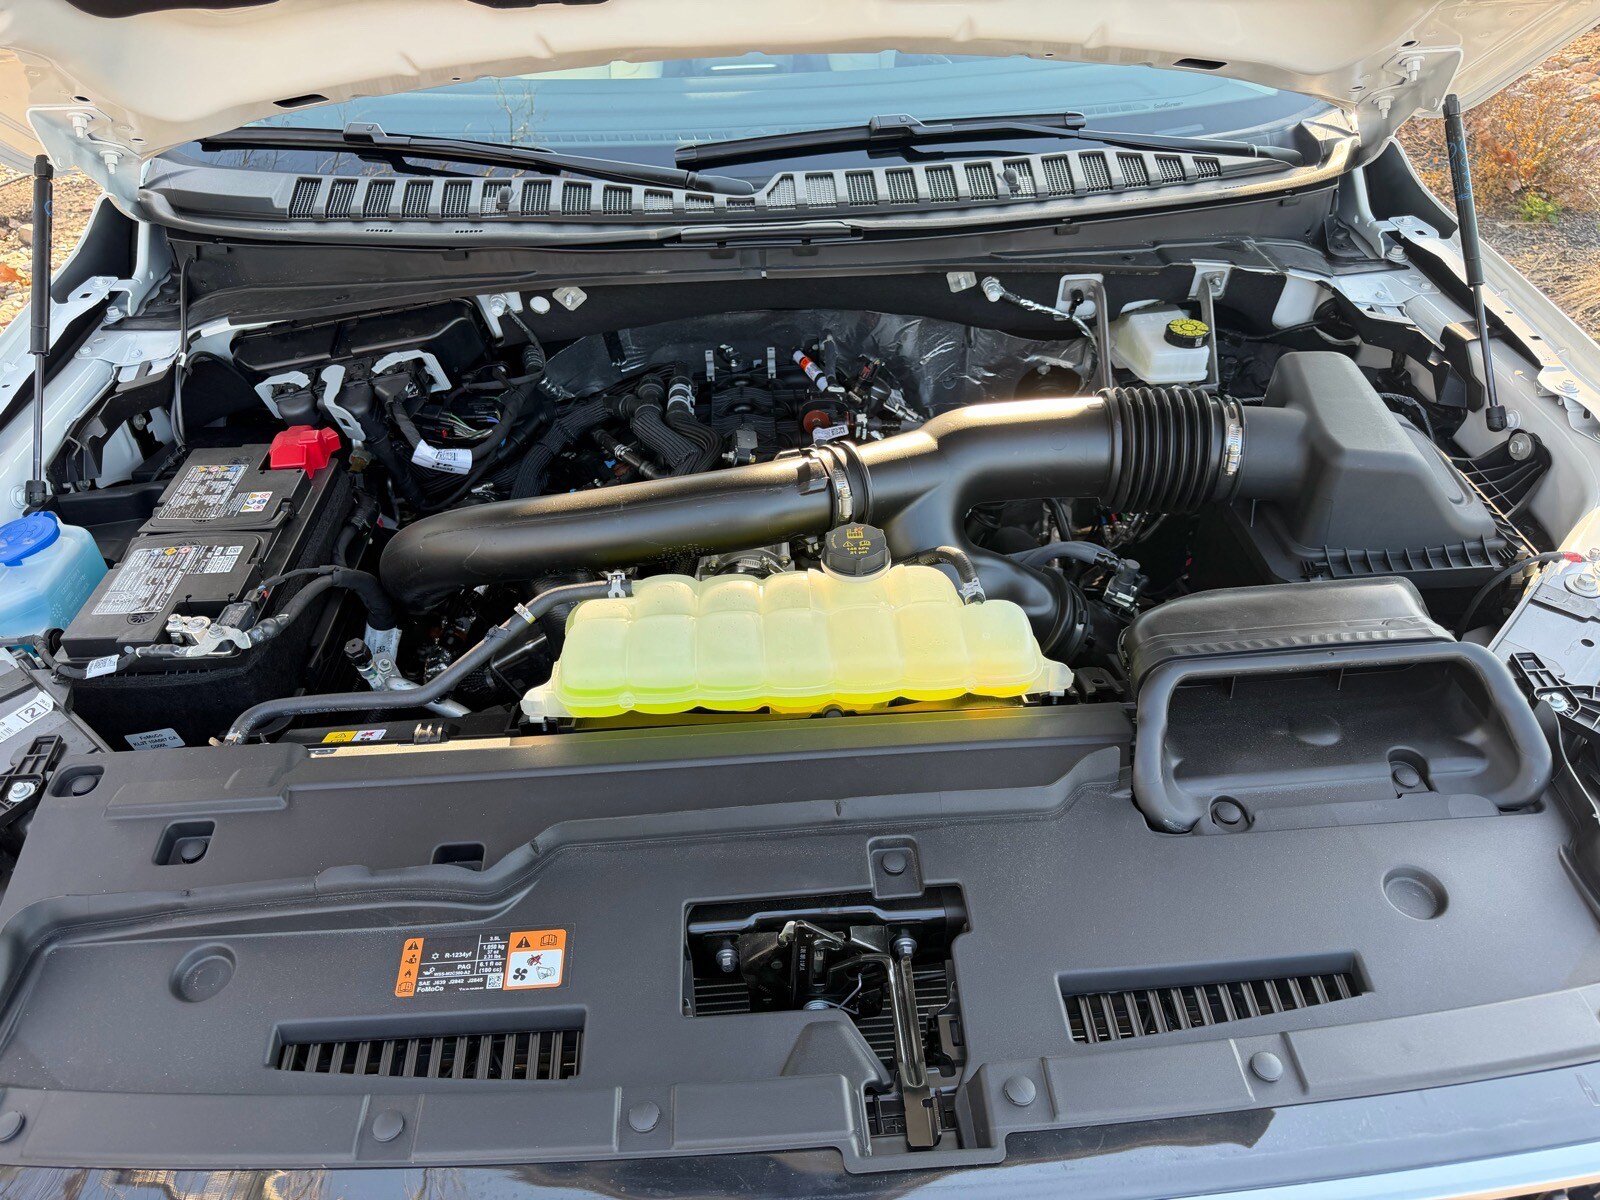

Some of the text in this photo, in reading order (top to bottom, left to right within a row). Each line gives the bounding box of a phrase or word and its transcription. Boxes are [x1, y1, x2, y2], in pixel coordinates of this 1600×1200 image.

[24, 707, 42, 719] 2
[139, 733, 163, 741] FoMoCo
[444, 951, 473, 959] R-1234yf
[416, 985, 445, 993] FoMoCo
